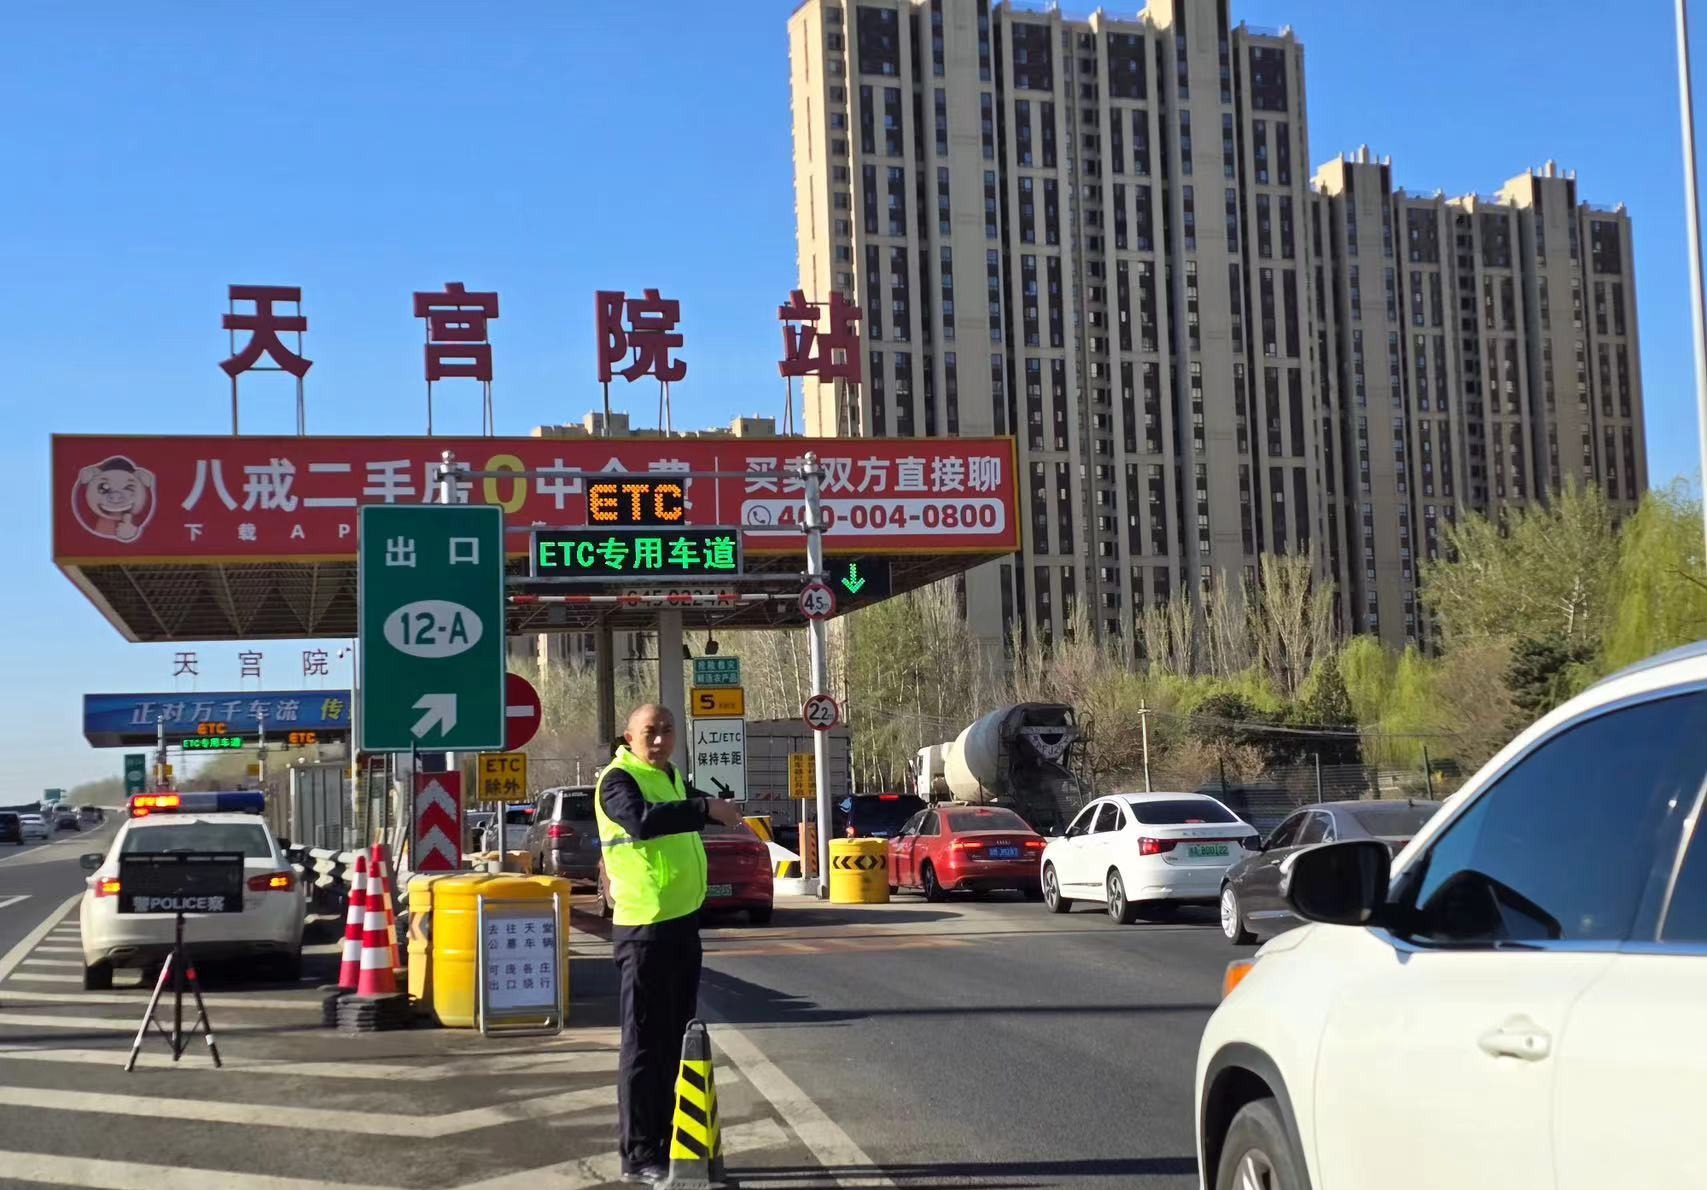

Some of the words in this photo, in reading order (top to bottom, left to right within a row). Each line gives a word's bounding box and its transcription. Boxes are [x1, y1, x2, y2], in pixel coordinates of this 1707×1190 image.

[218, 282, 862, 383] 天宫院站
[589, 484, 682, 520] ETC
[385, 535, 480, 568] 出口
[539, 536, 735, 571] ETC专用车道
[400, 611, 469, 646] 12-A
[172, 649, 329, 678] 天宫院
[129, 700, 300, 725] 正对万千车流
[320, 698, 351, 721] 传
[700, 694, 715, 710] 5
[197, 723, 227, 734] ETC
[289, 732, 316, 743] ETC
[697, 731, 741, 745] 人工/ETC
[486, 758, 521, 772] ETC
[698, 752, 742, 766] 保持车距
[485, 778, 520, 795] 除外
